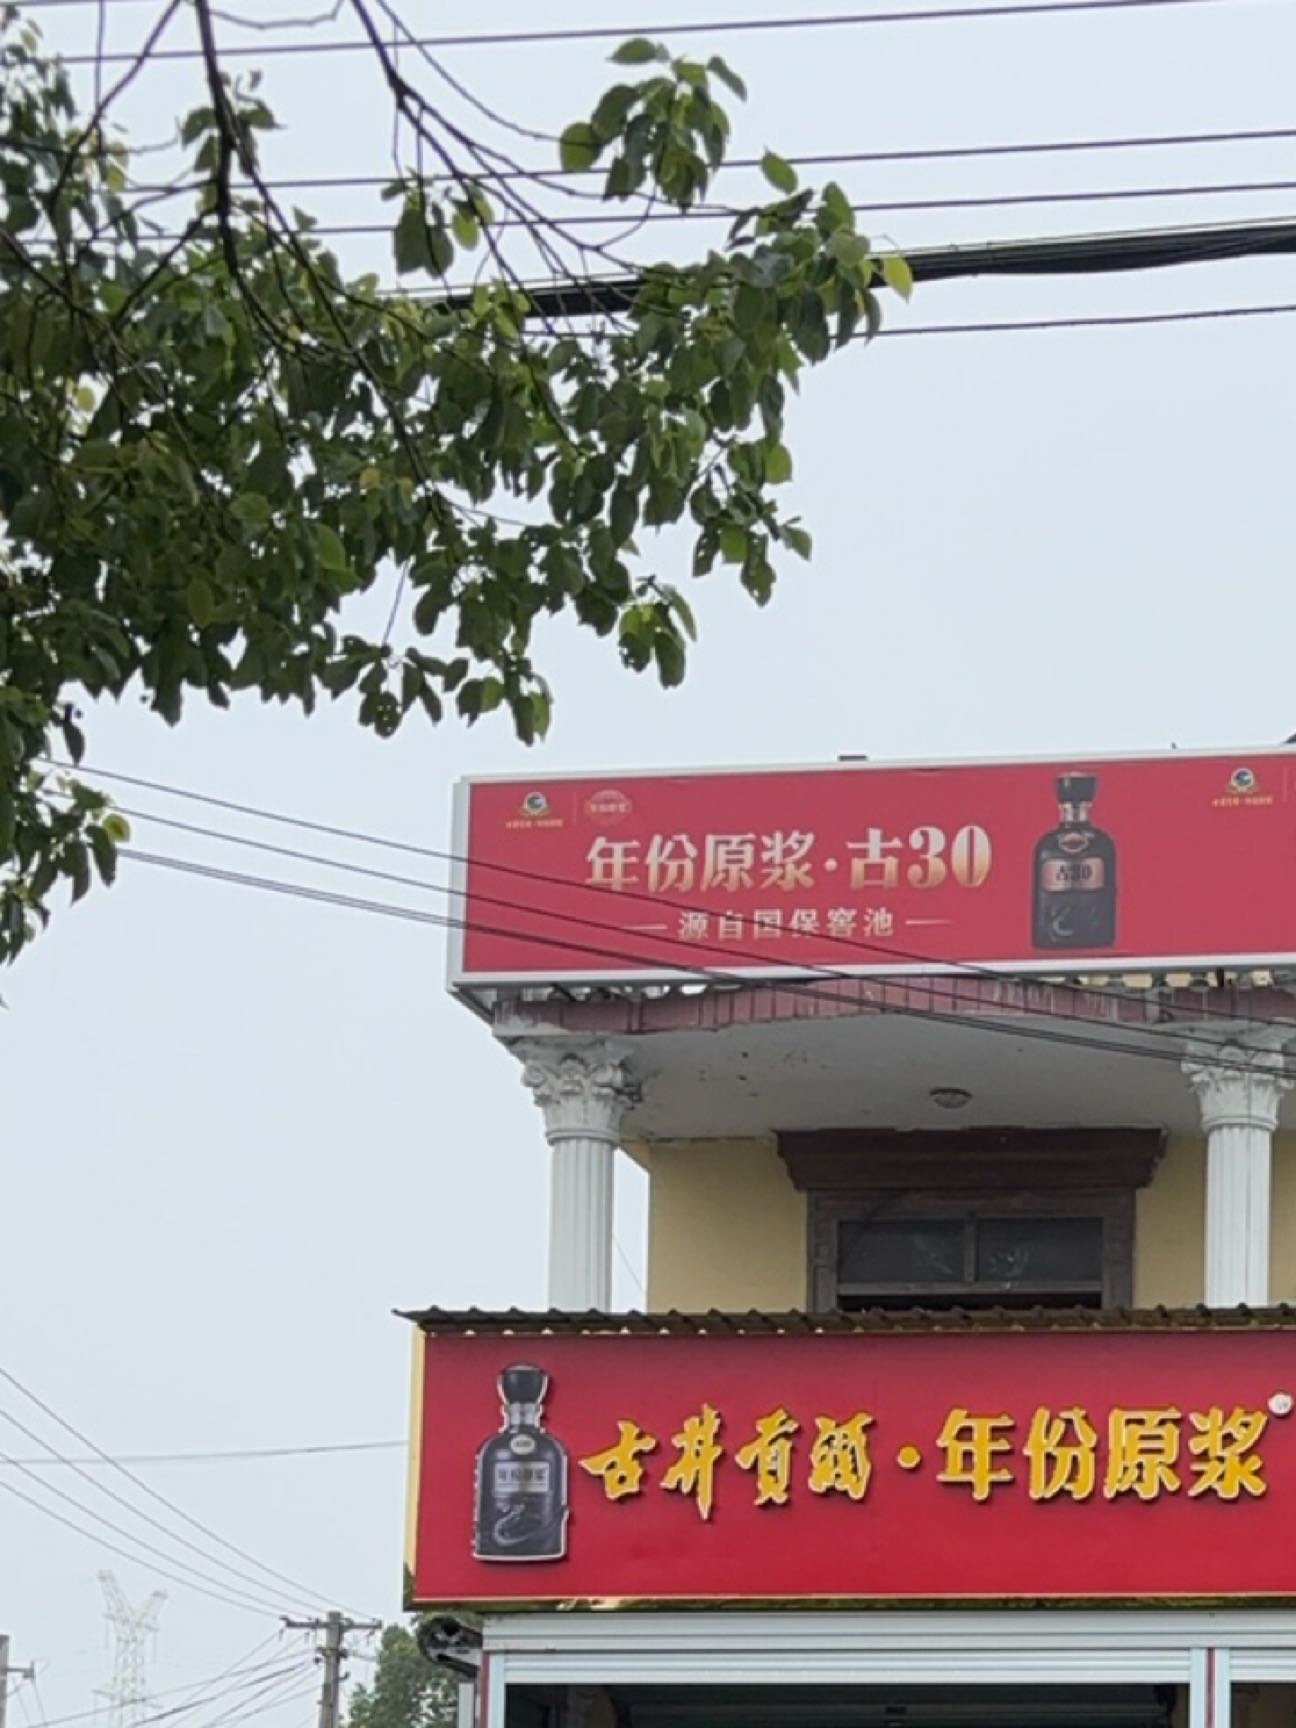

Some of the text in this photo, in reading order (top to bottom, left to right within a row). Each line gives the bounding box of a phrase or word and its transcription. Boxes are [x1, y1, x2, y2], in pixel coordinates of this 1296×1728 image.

[584, 824, 992, 895] 年份原浆·古30
[677, 907, 895, 942] 源自国保窖池
